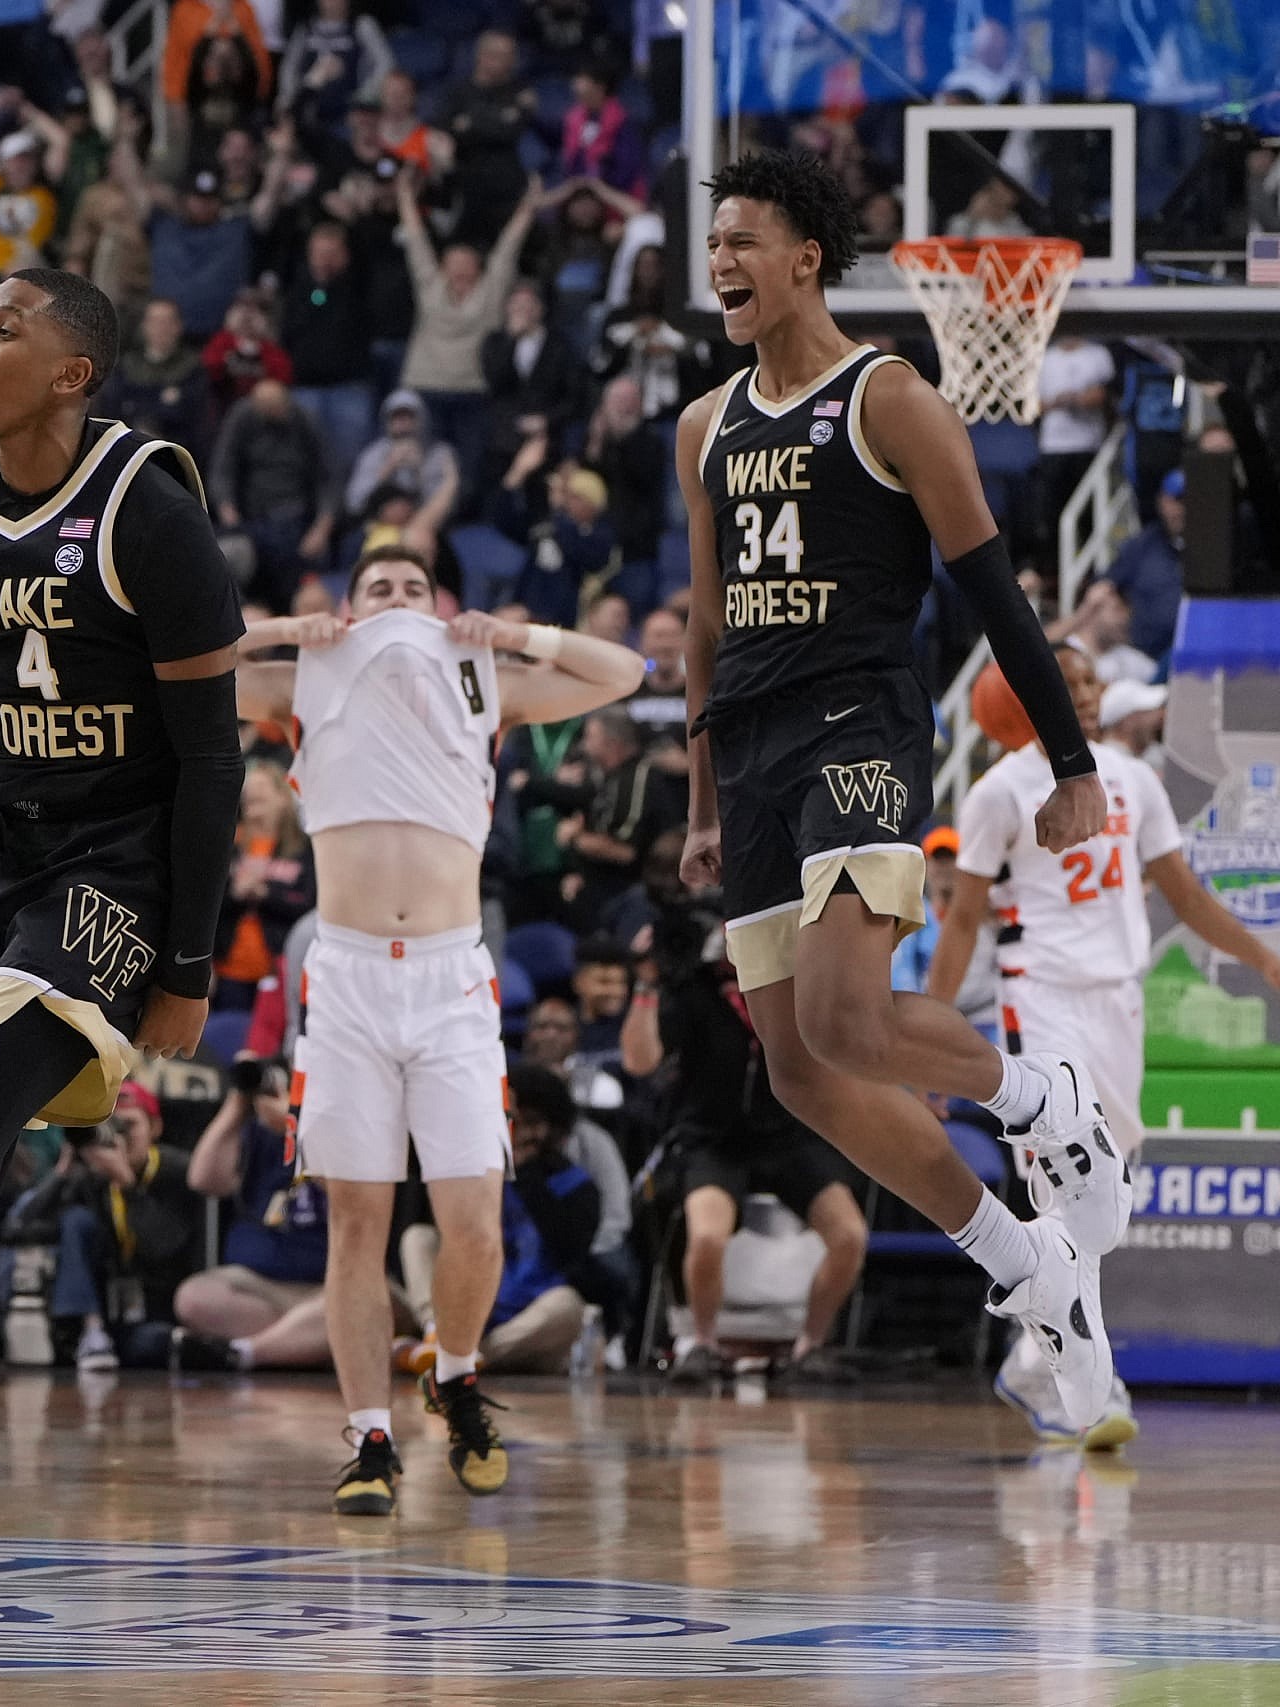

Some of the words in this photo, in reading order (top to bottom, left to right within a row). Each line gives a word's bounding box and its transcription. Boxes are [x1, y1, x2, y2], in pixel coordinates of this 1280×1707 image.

[726, 446, 814, 497] WAKE
[735, 500, 804, 574] 34
[726, 580, 837, 628] FOREST
[16, 628, 61, 700] 4
[821, 760, 908, 835] WF
[1062, 846, 1125, 905] 24
[62, 884, 157, 1002] WF
